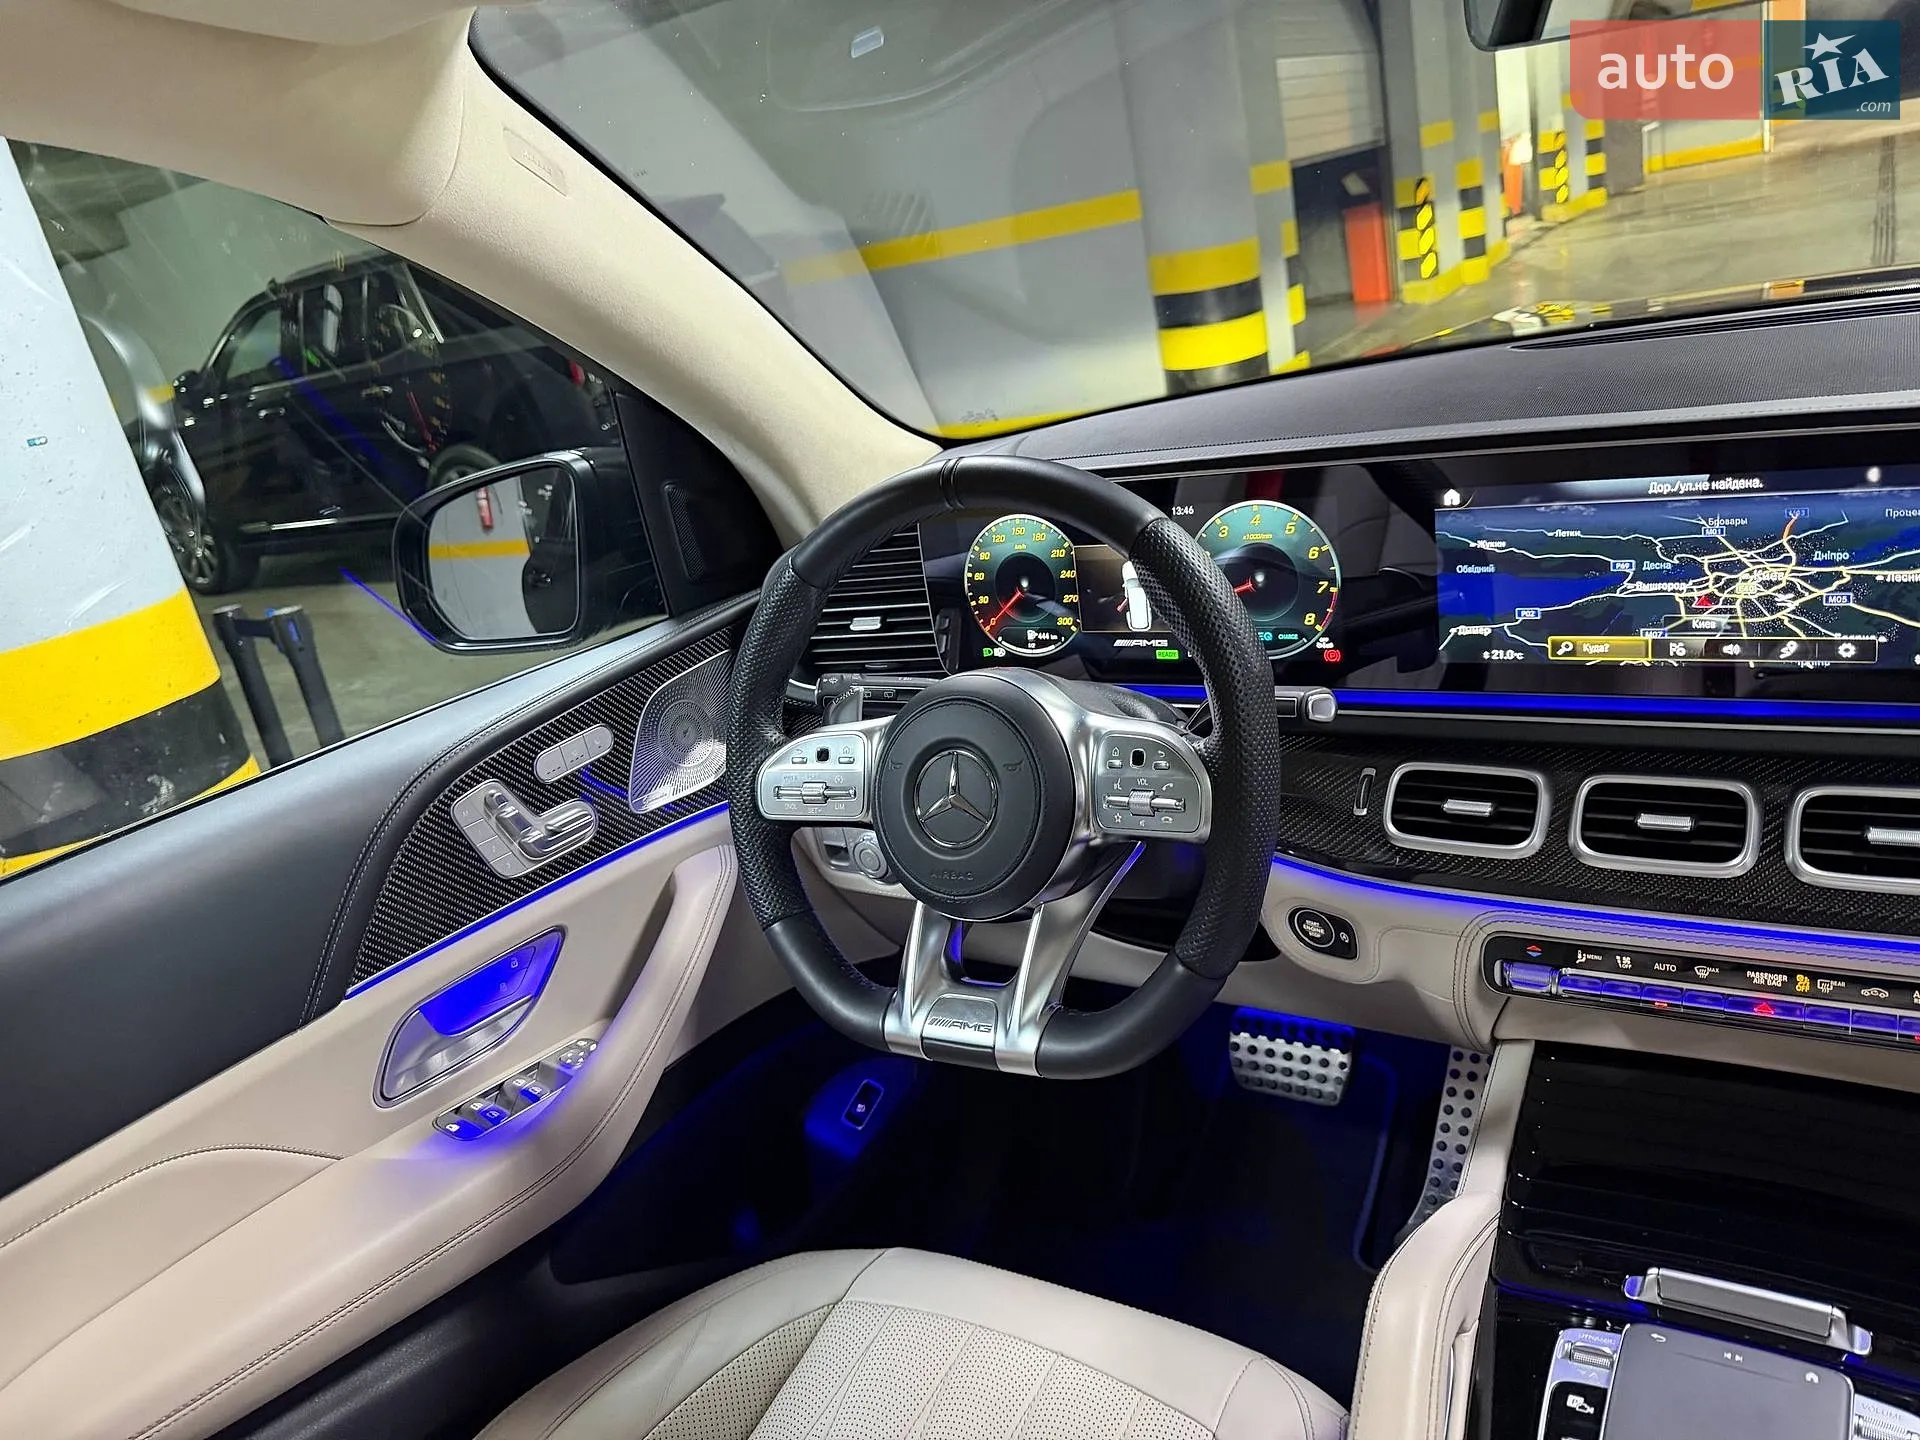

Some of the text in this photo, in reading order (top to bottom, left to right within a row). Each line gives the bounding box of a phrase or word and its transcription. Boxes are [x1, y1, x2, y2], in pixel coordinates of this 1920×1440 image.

[1172, 506, 1194, 516] 13:46
[1250, 514, 1261, 526] 4
[1708, 517, 1748, 526] Бровары
[1218, 526, 1228, 537] 3
[1285, 522, 1297, 535] 5
[992, 534, 1006, 543] 120
[1050, 549, 1065, 558] 210
[1307, 546, 1319, 560] 6
[1813, 551, 1850, 562] Дніпро
[1642, 560, 1673, 571] Десна
[974, 572, 985, 581] 60
[1060, 570, 1076, 579] 240
[1316, 581, 1329, 593] 7
[978, 596, 989, 605] 30
[1063, 594, 1078, 603] 270
[1056, 617, 1073, 627] 300
[1304, 613, 1316, 626] 8
[1692, 619, 1716, 630] Киев
[1582, 643, 1610, 654] Куда?
[1653, 962, 1677, 973] AUTO
[1746, 970, 1788, 983] PASSENGER
